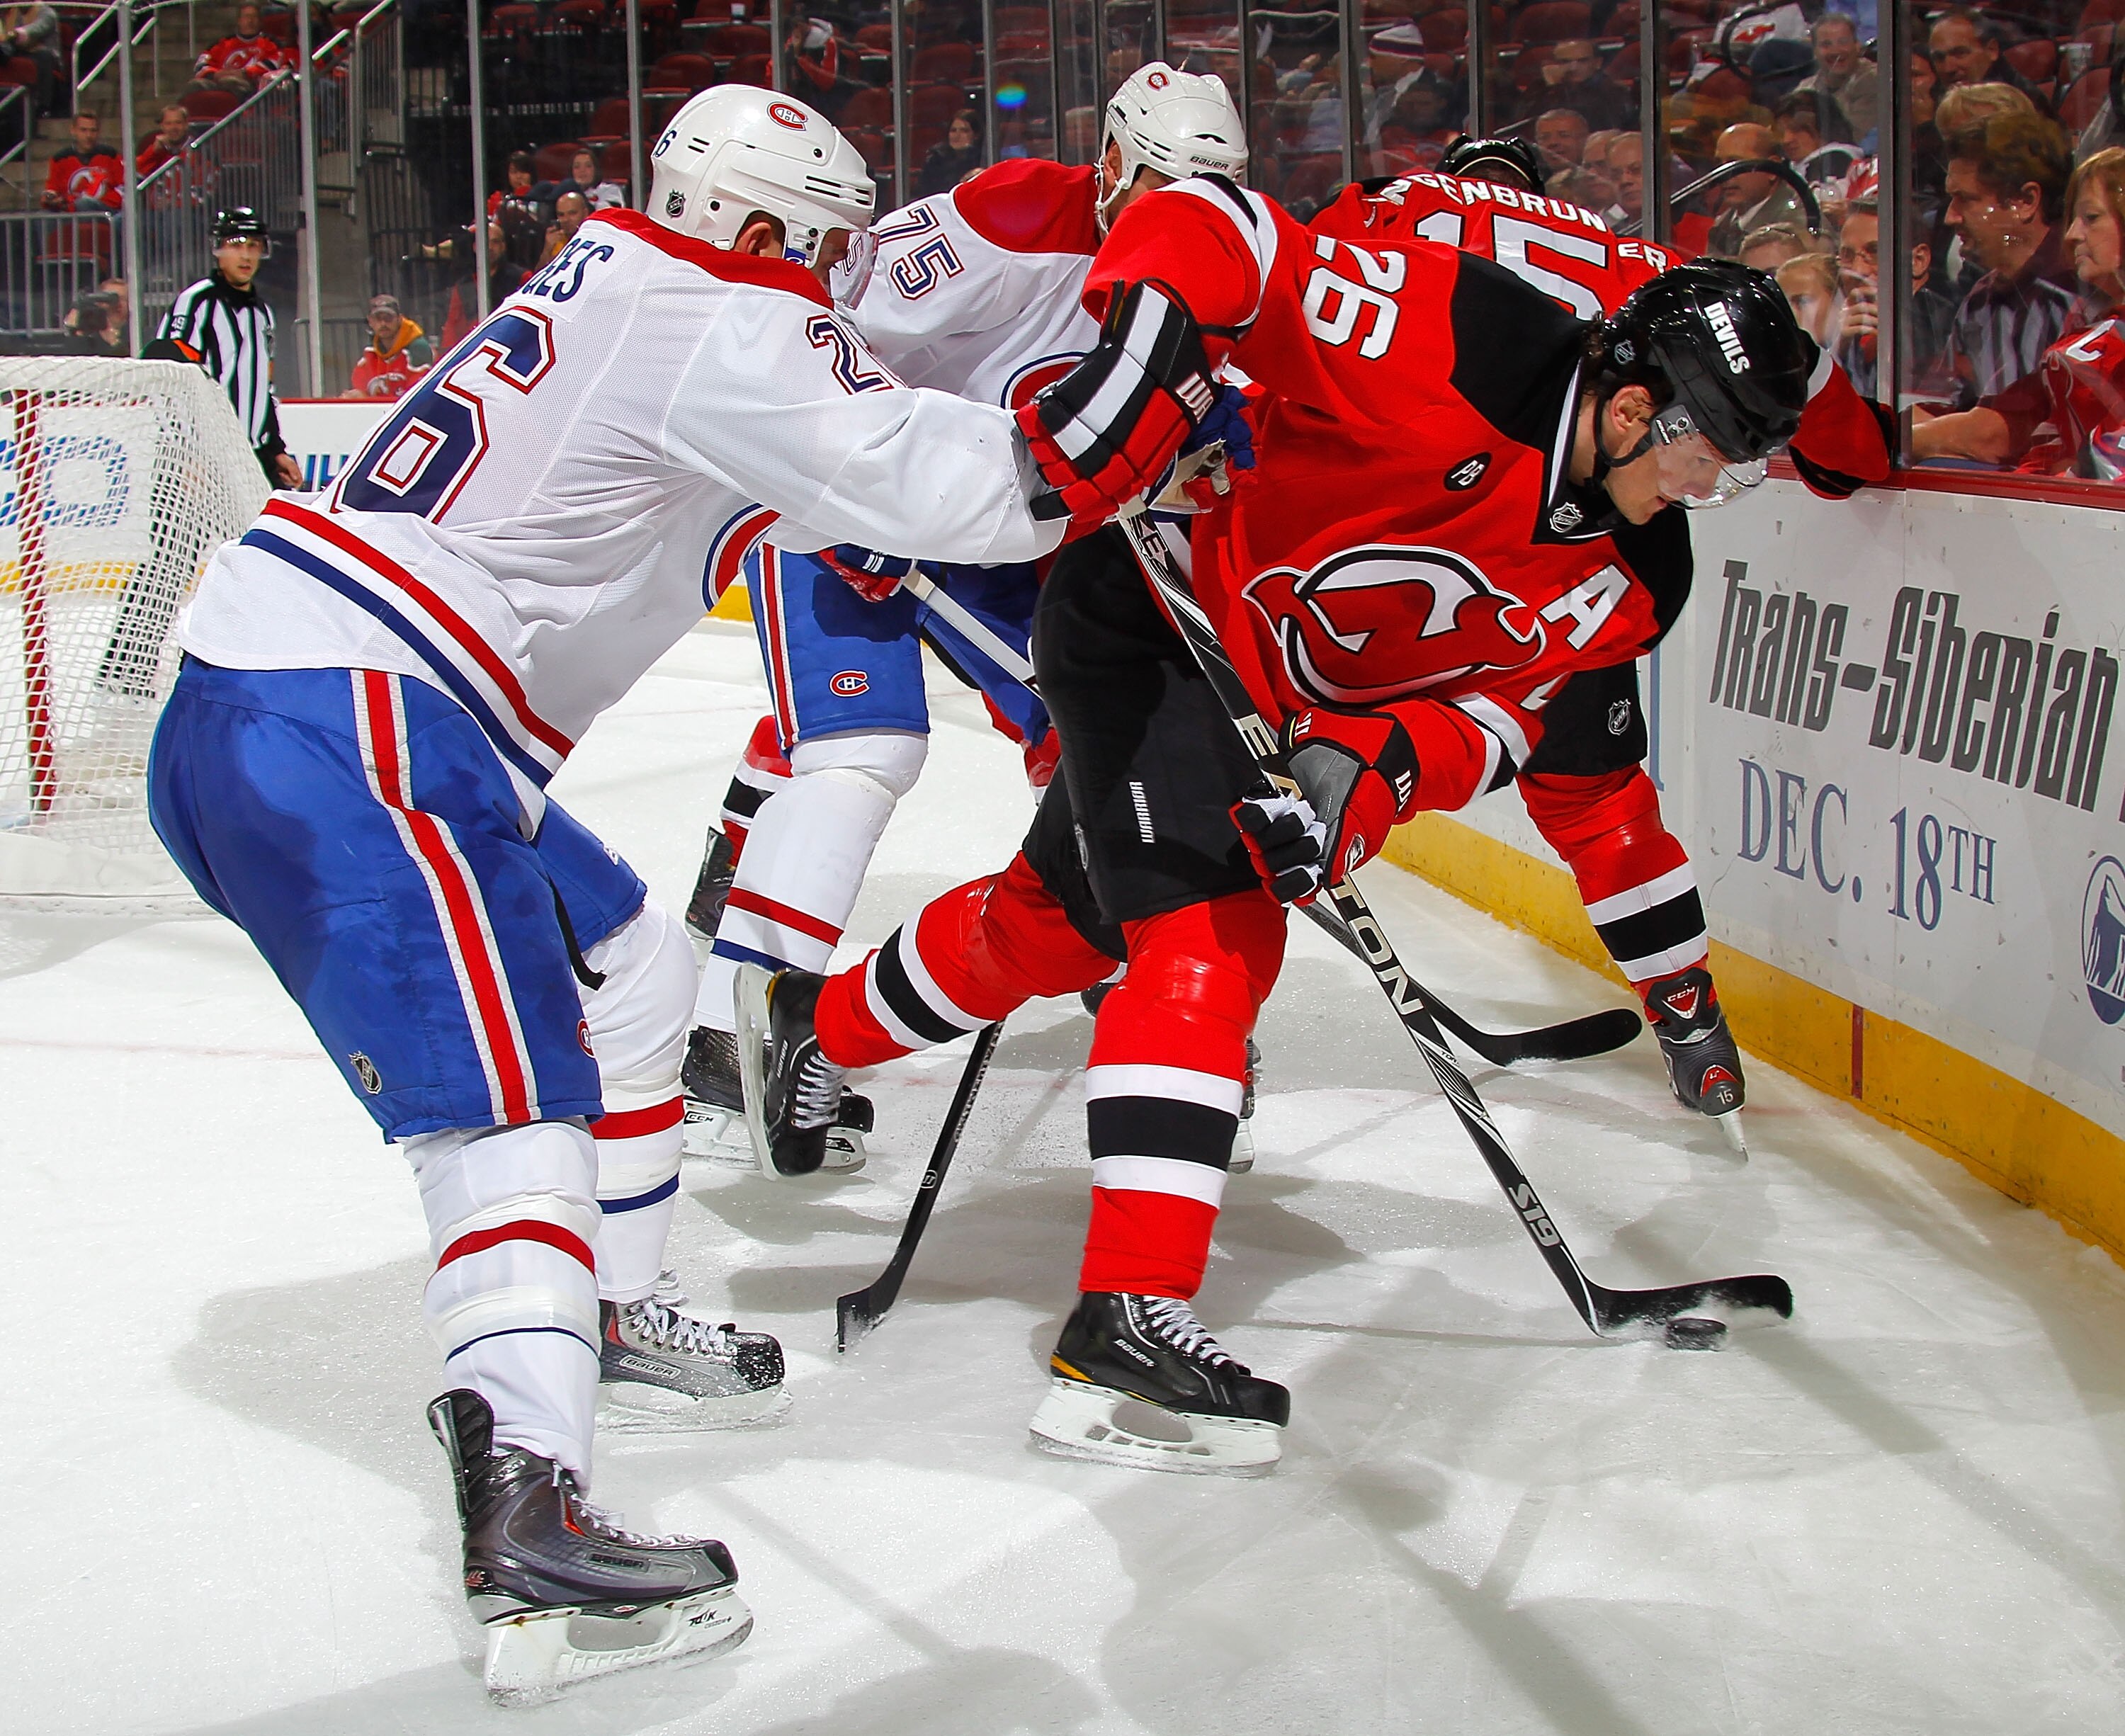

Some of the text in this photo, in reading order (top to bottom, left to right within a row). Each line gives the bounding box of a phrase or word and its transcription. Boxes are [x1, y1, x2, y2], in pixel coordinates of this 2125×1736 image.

[1190, 155, 1229, 171] BAUER
[878, 203, 965, 300] 75
[1417, 211, 1609, 322] 15
[1704, 301, 1751, 374] DEVILS
[331, 305, 557, 523] 6
[1450, 460, 1485, 486] PB
[1538, 564, 1631, 650] A
[1128, 781, 1156, 844] WARRIOR
[1738, 758, 1998, 932] DEC. 18TH
[1667, 987, 1696, 1003] CCM
[688, 1113, 714, 1123] CCM
[1716, 1089, 1734, 1105] 15
[1508, 1183, 1560, 1247] S19
[626, 1358, 674, 1376] BAUER
[1114, 1339, 1155, 1367] BAUER
